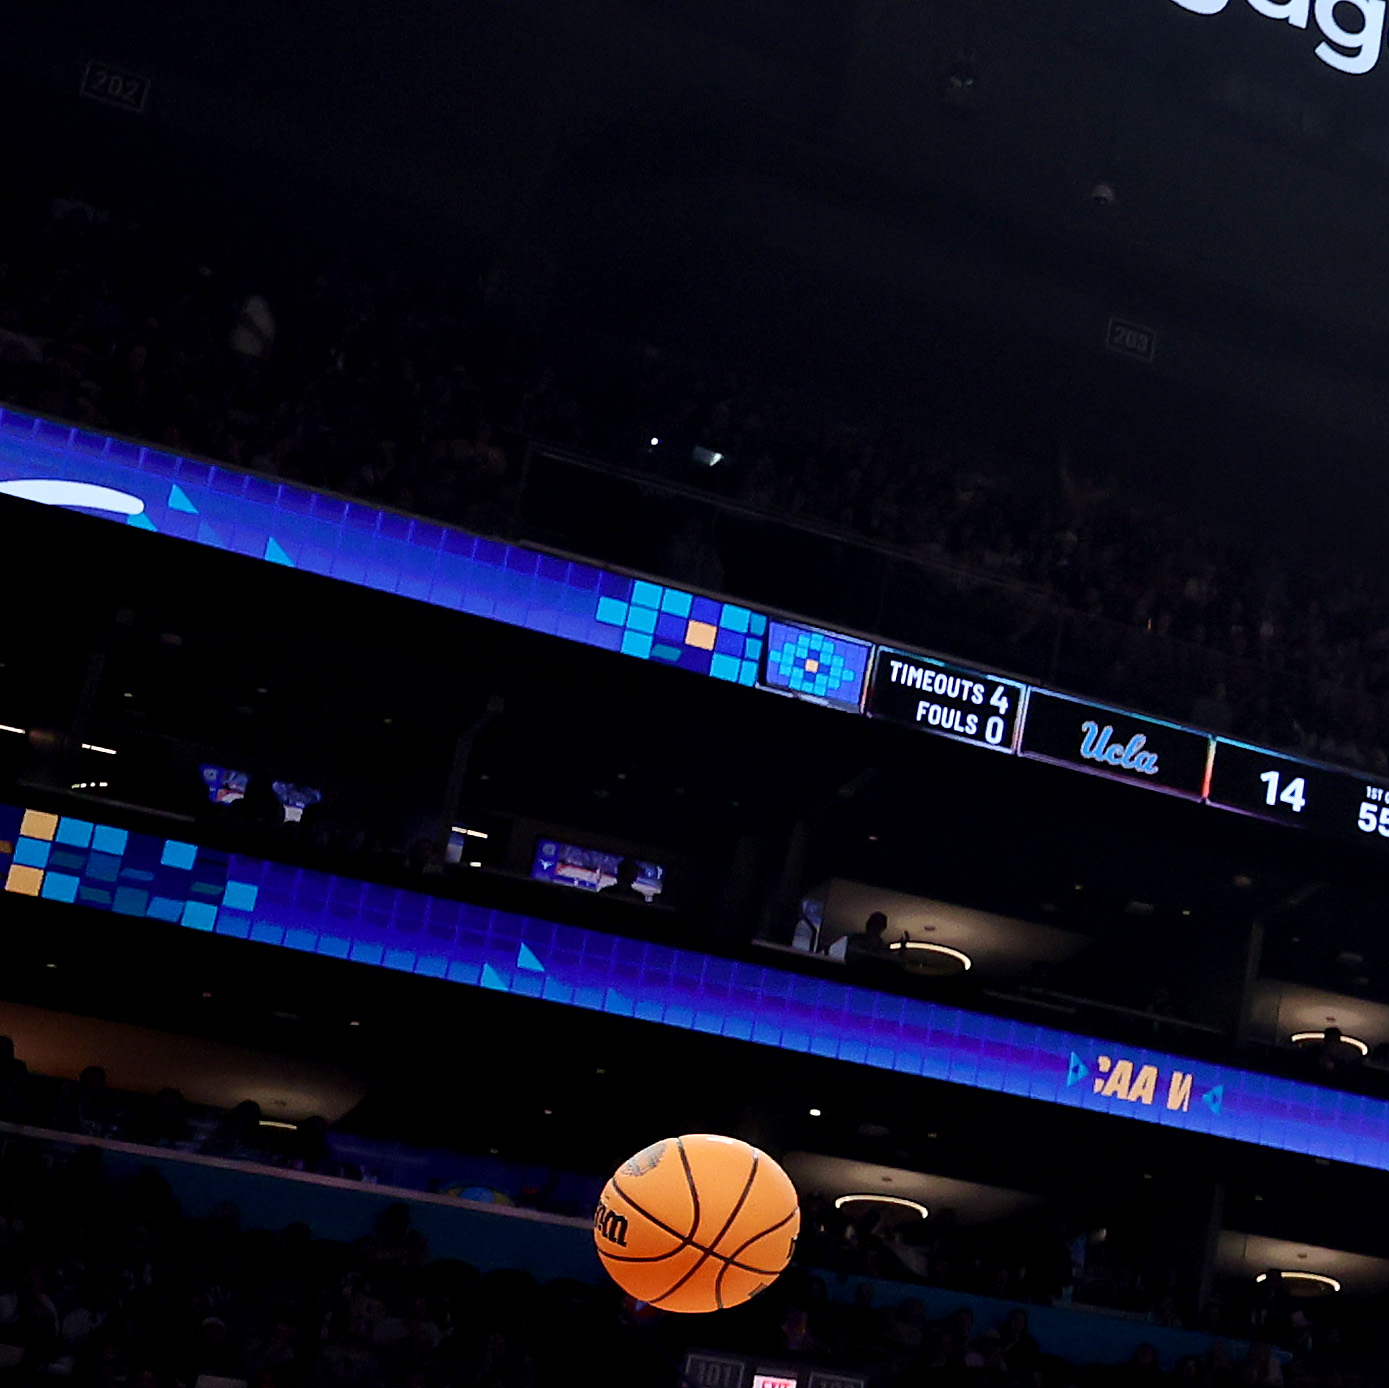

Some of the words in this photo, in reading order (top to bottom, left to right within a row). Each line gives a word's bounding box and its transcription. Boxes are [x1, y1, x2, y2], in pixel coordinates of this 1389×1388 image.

[890, 660, 985, 705] TIMEOUTS
[989, 686, 1009, 715] 4
[917, 701, 979, 736] FOULS
[984, 716, 1004, 745] 0
[1079, 721, 1159, 774] Ucla
[1260, 770, 1306, 813] 14
[1366, 786, 1383, 802] 1ST
